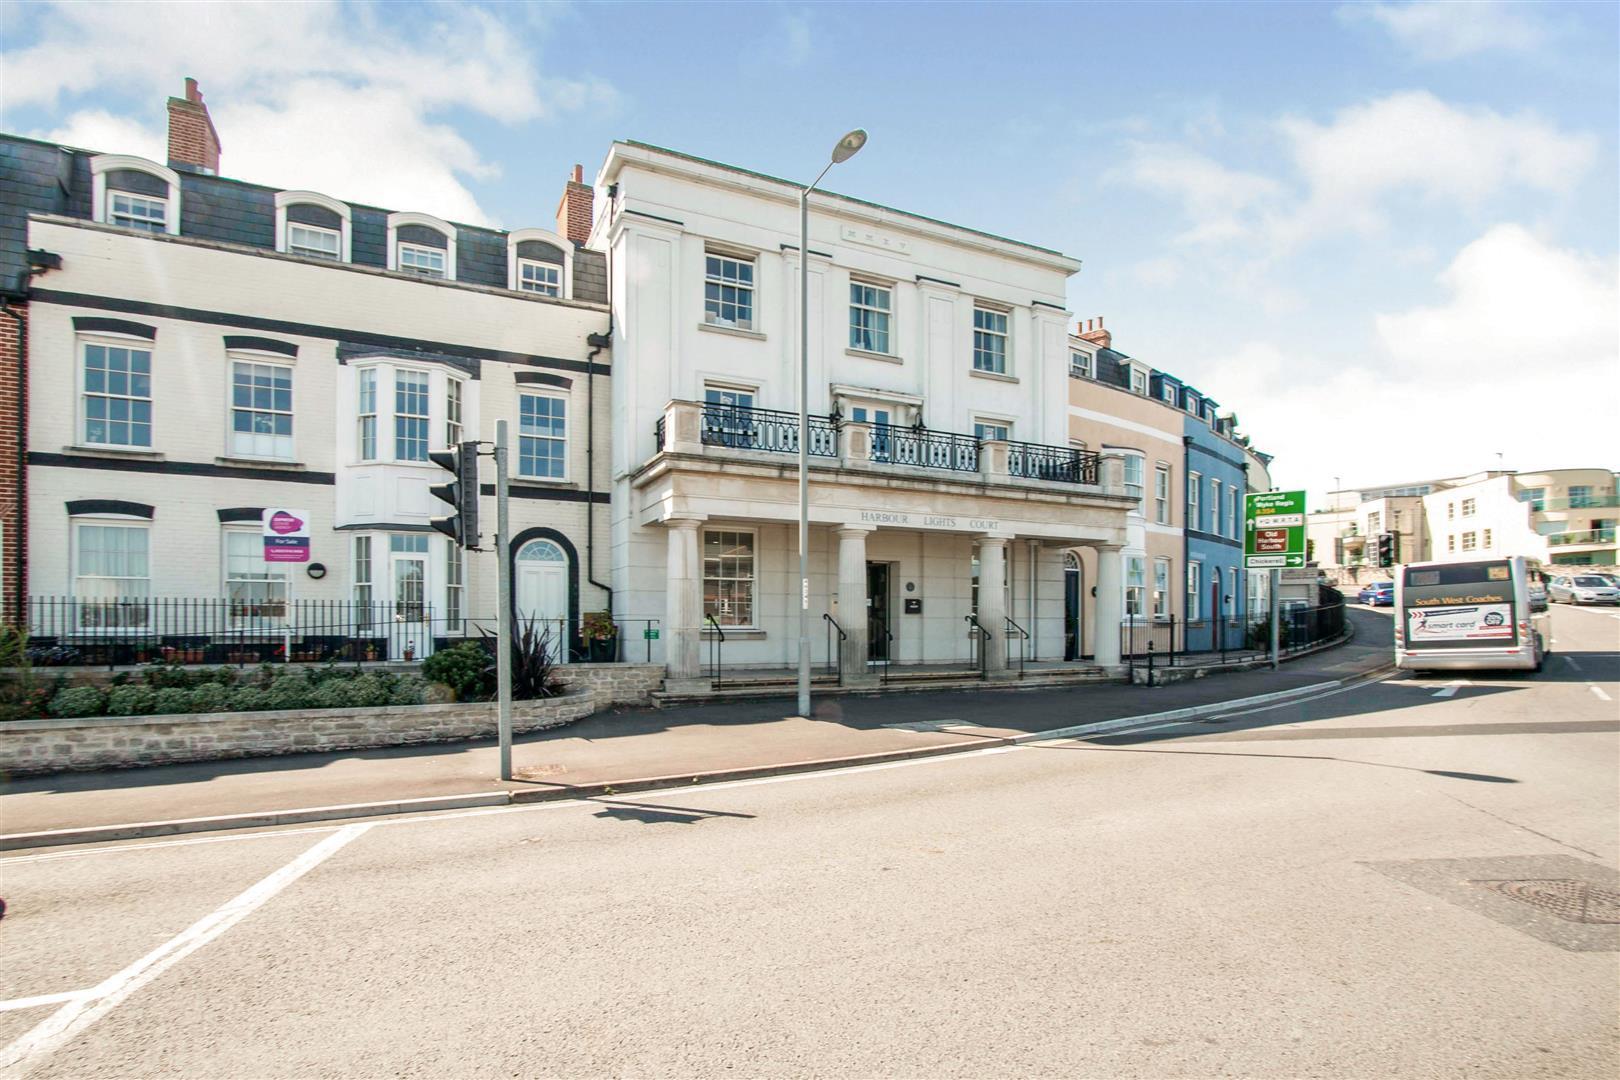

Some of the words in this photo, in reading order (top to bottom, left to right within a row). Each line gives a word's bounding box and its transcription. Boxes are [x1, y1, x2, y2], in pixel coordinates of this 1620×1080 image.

[861, 512, 909, 523] HARBOUR
[923, 516, 956, 527] LIGHTS
[969, 519, 1000, 530] COURT
[1415, 597, 1441, 606] South
[1441, 596, 1464, 605] West
[1466, 594, 1504, 604] Coaches
